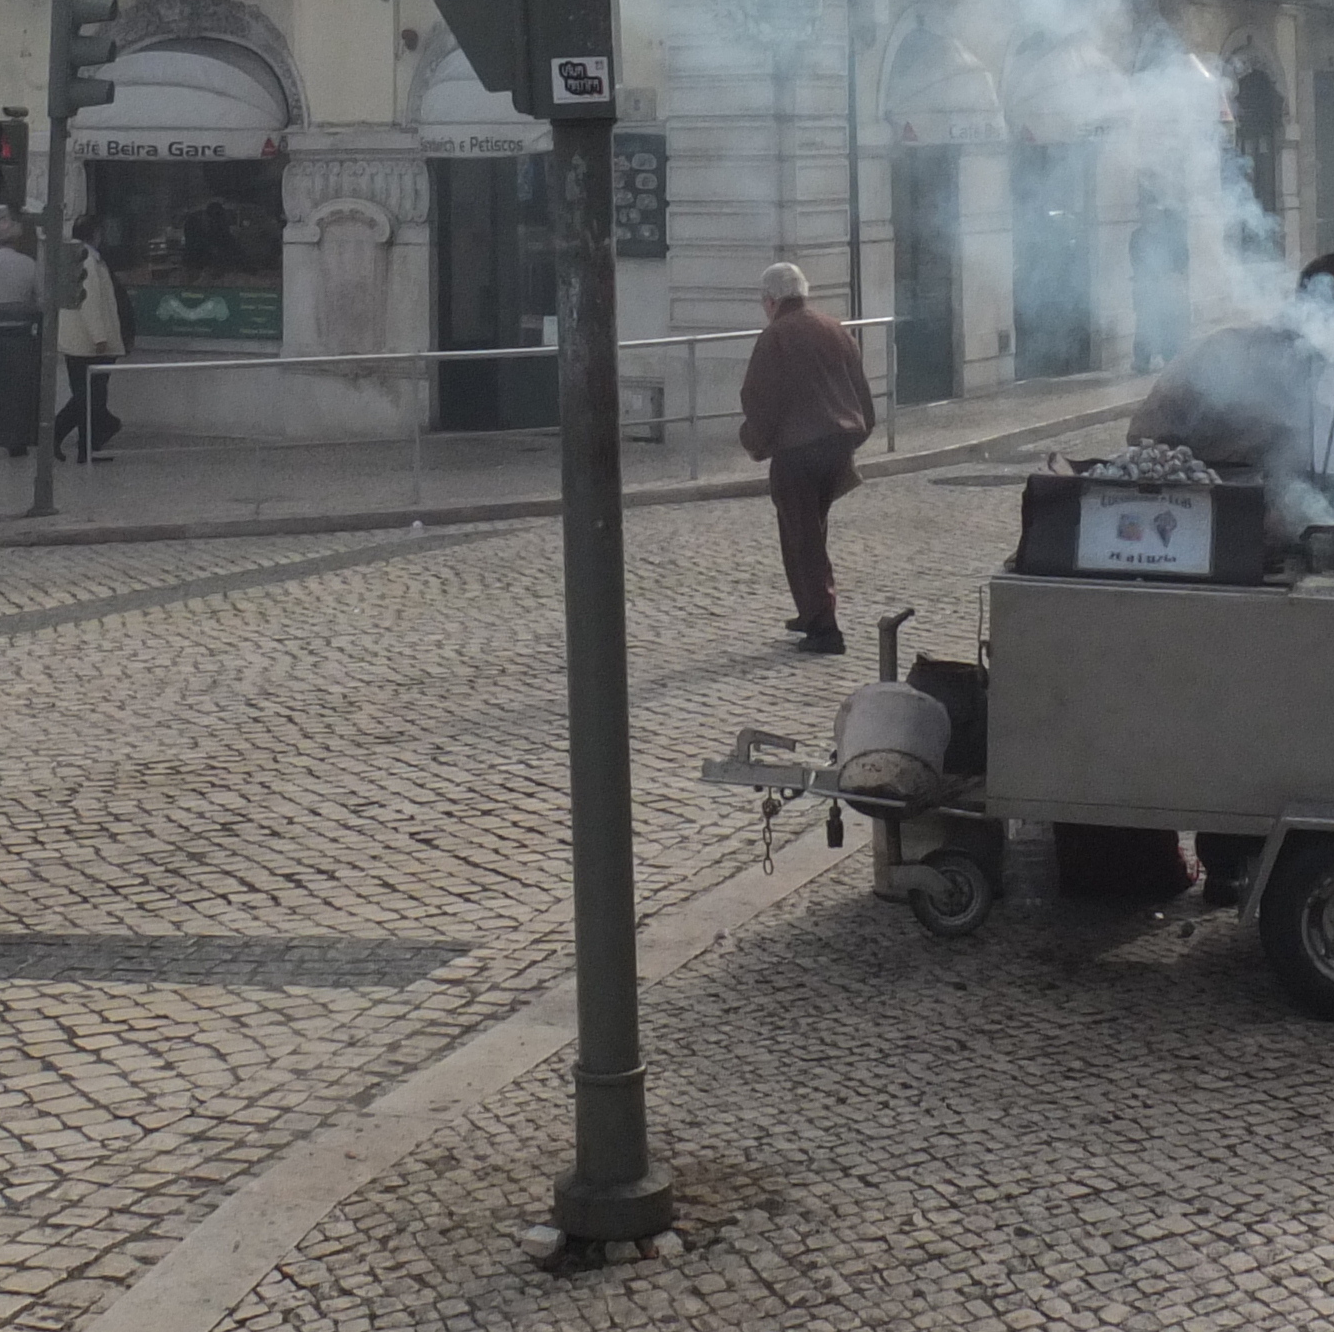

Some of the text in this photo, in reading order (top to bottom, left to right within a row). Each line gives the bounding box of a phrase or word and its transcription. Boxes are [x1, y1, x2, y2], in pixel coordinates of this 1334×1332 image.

[107, 140, 159, 157] Beira
[168, 141, 226, 158] Gare
[469, 135, 524, 154] Petiscos
